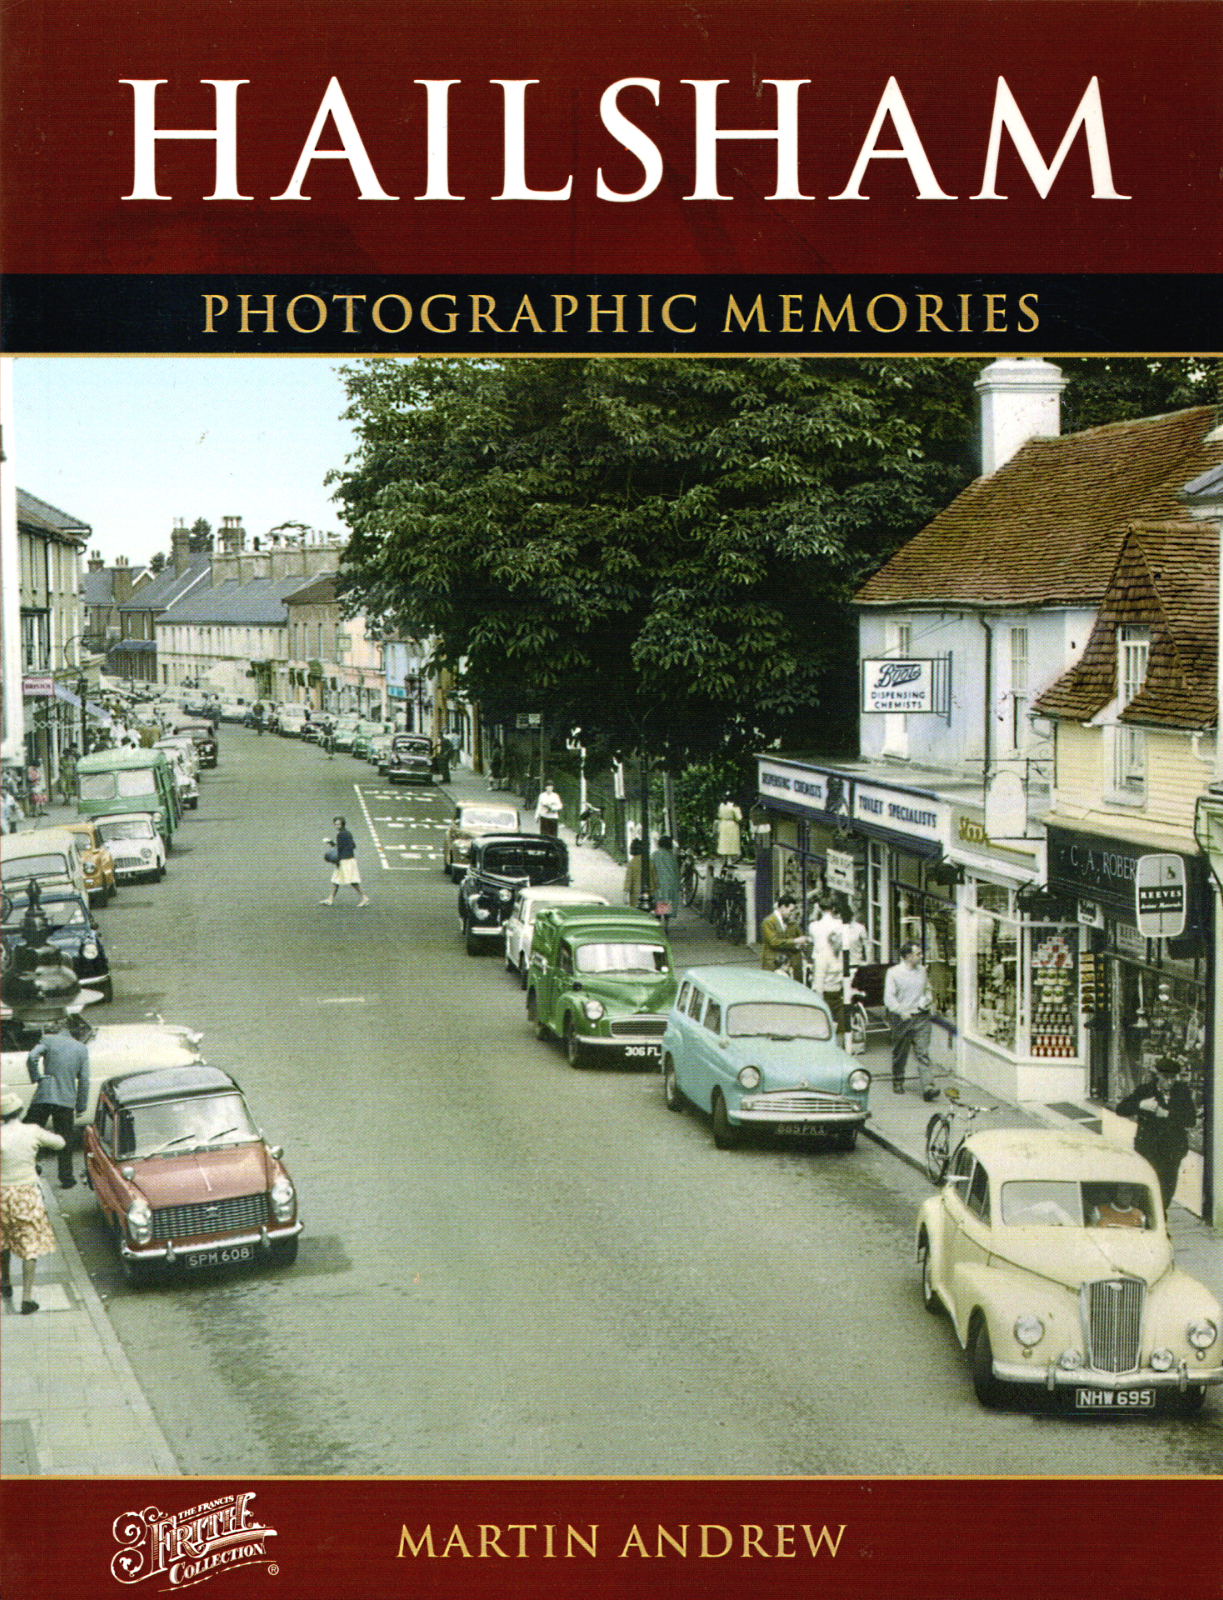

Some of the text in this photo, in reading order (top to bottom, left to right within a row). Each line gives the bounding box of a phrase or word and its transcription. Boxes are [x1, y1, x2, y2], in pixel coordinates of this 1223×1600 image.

[874, 663, 922, 687] Boots
[871, 691, 926, 700] DISPENSING
[874, 701, 923, 709] CHEMISTS
[761, 772, 822, 799] DISPENSING CHEMISTS
[858, 795, 937, 828] TOILET SPECIALISTS
[1103, 851, 1138, 881] ROBER
[1140, 890, 1182, 899] REEVES
[625, 1046, 646, 1056] 306
[189, 1248, 249, 1266] SPM 608
[1079, 1391, 1151, 1405] NHW 695
